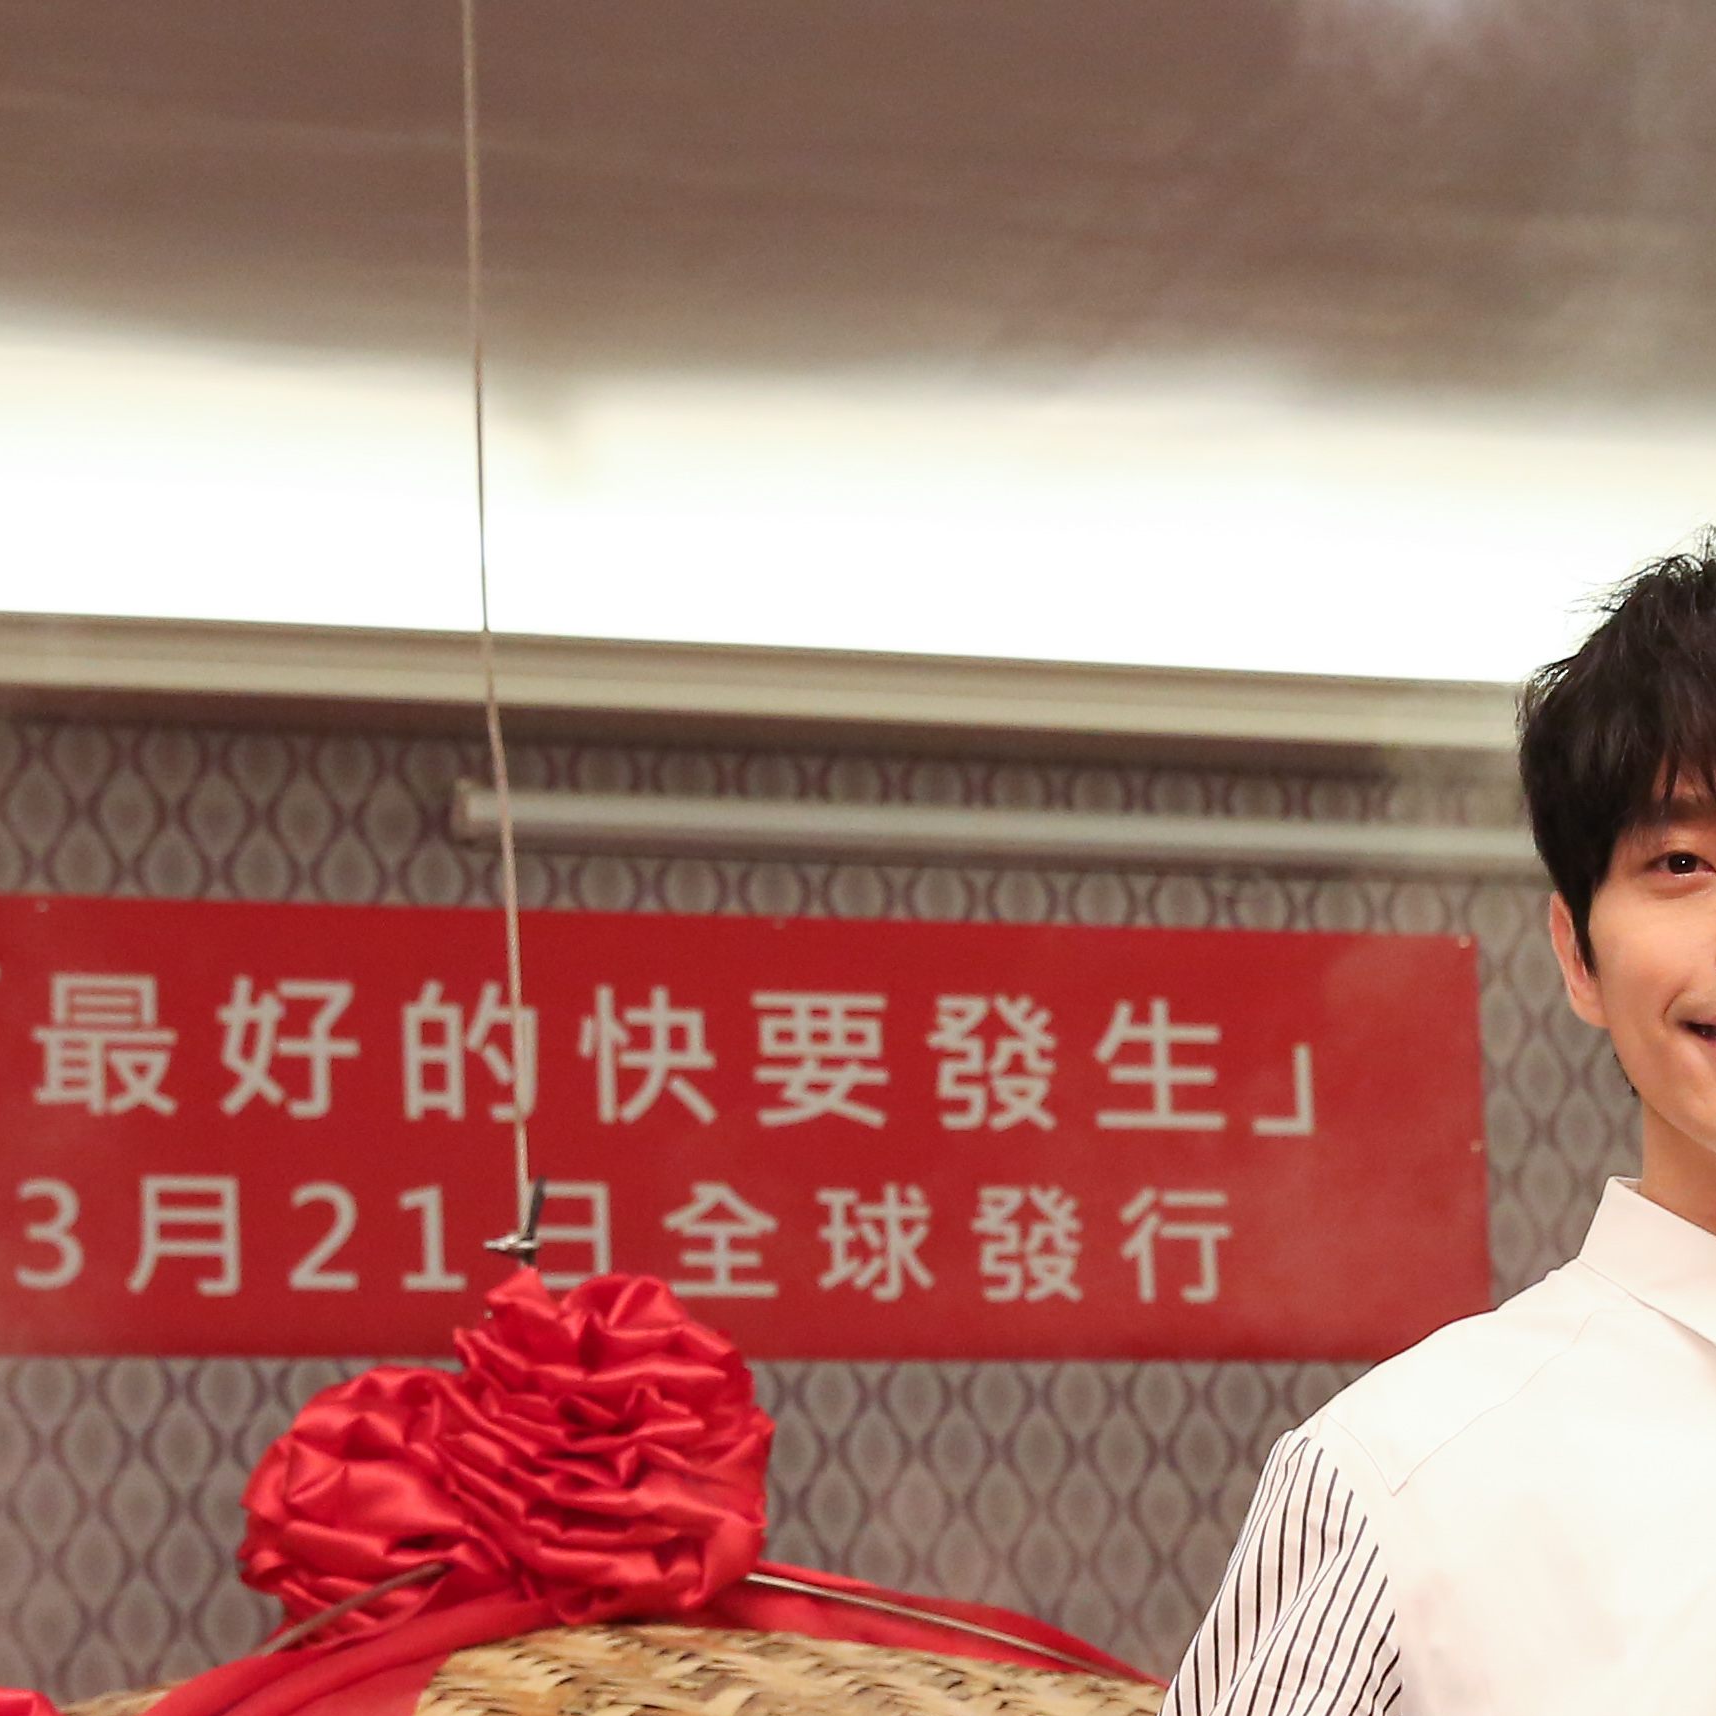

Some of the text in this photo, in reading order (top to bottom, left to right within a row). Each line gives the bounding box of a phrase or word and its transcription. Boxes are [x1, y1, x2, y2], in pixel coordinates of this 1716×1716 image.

[15, 1175, 1234, 1304] 3月21日全球發行
